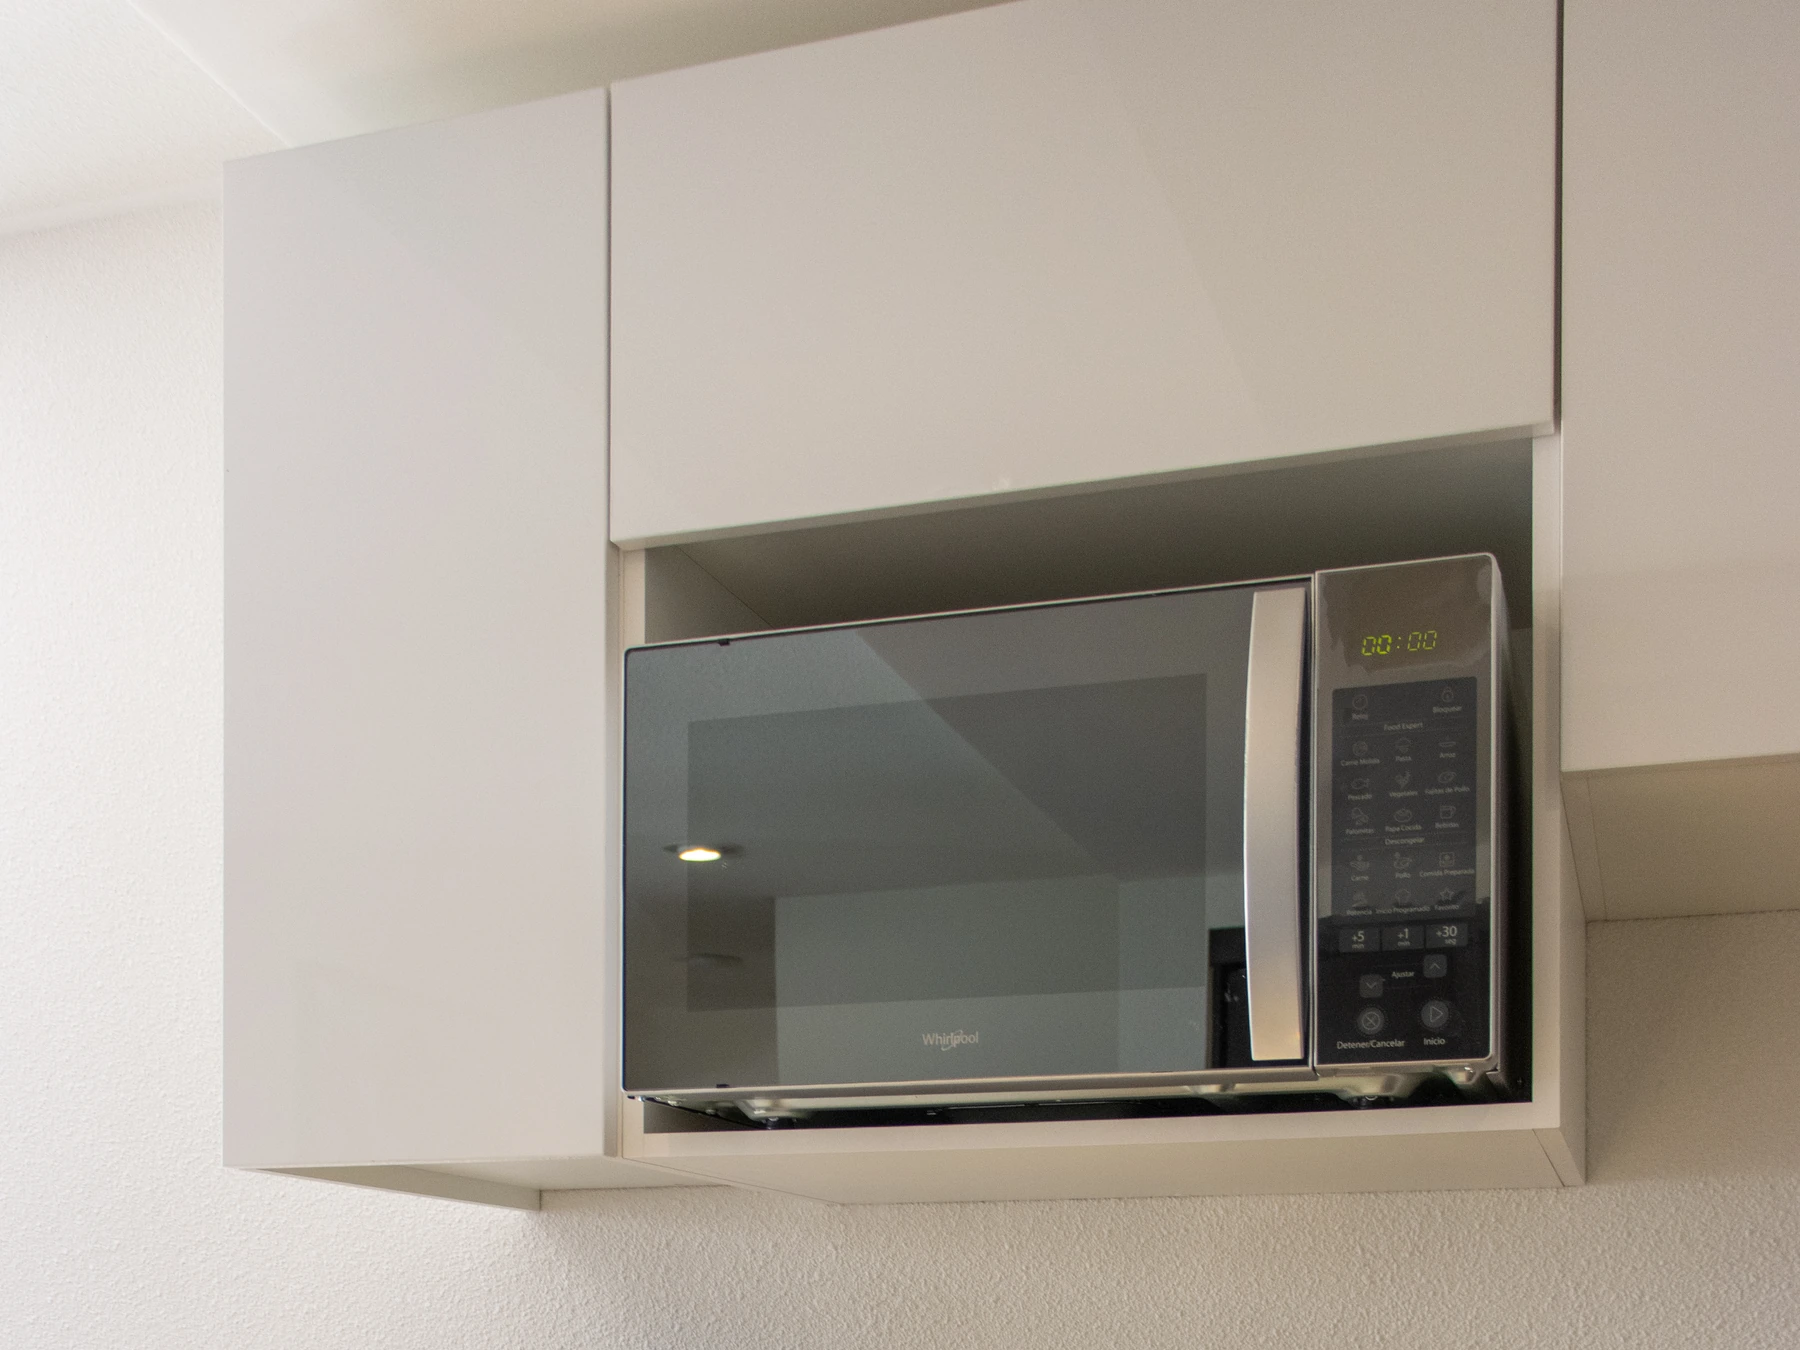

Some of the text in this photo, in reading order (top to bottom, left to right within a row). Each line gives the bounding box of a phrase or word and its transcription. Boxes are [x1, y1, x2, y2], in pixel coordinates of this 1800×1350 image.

[1361, 630, 1438, 656] 00:00
[1352, 930, 1365, 942] +5
[1398, 928, 1409, 939] +1
[1436, 925, 1458, 937] +30
[1391, 971, 1415, 979] Ajustar
[922, 1029, 979, 1051] Whirlpool
[1336, 1039, 1405, 1049] Detener/Cancelar
[1423, 1037, 1446, 1045] Inicio
